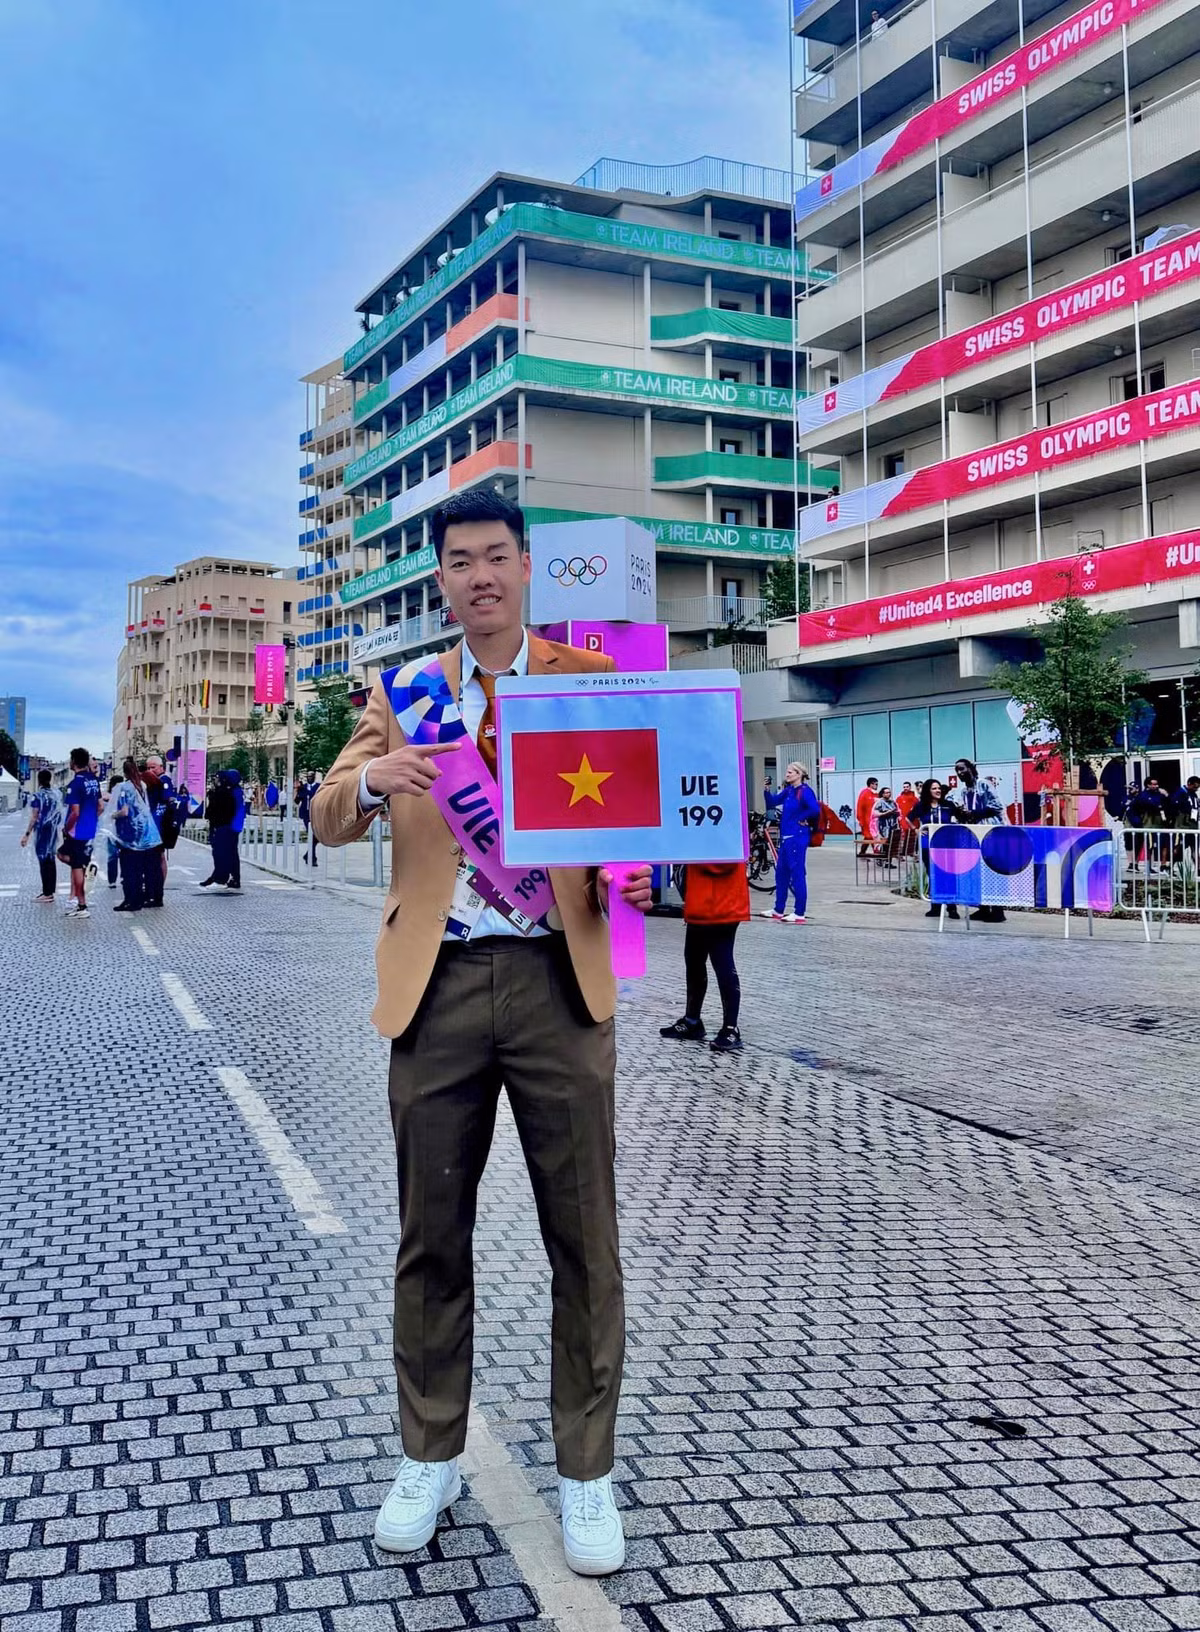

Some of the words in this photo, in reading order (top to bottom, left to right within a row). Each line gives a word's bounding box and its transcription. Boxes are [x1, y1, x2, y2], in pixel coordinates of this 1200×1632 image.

[958, 64, 1016, 114] SWISS
[1028, 2, 1114, 71] OLYMPIC
[609, 225, 659, 248] TEAM
[663, 233, 734, 257] IRELAND
[756, 248, 800, 271] TEAM
[965, 316, 1024, 357] SWISS
[1037, 275, 1125, 328] OLYMPIC
[456, 385, 477, 412] TEAM
[478, 362, 513, 399] IRELAND
[613, 370, 661, 393] TEAM
[666, 375, 737, 402] IRELAND
[399, 425, 417, 449] TEAM
[967, 445, 1028, 482] SWISS
[1040, 412, 1130, 458] OLYMPIC
[669, 525, 740, 546] IRELAND
[398, 554, 418, 577] TEAM
[631, 553, 651, 577] PARIS
[350, 578, 367, 598] TEAM
[366, 567, 391, 591] IRELAND
[631, 574, 652, 597] 2024
[879, 597, 943, 623] #United4
[946, 579, 1033, 610] Excellence
[589, 636, 599, 650] D
[592, 678, 619, 686] PARIS
[622, 677, 646, 685] 2024
[680, 775, 719, 796] VIE
[447, 782, 500, 855] VIE
[678, 805, 723, 827] 199
[513, 869, 547, 901] 199
[461, 927, 469, 938] R
